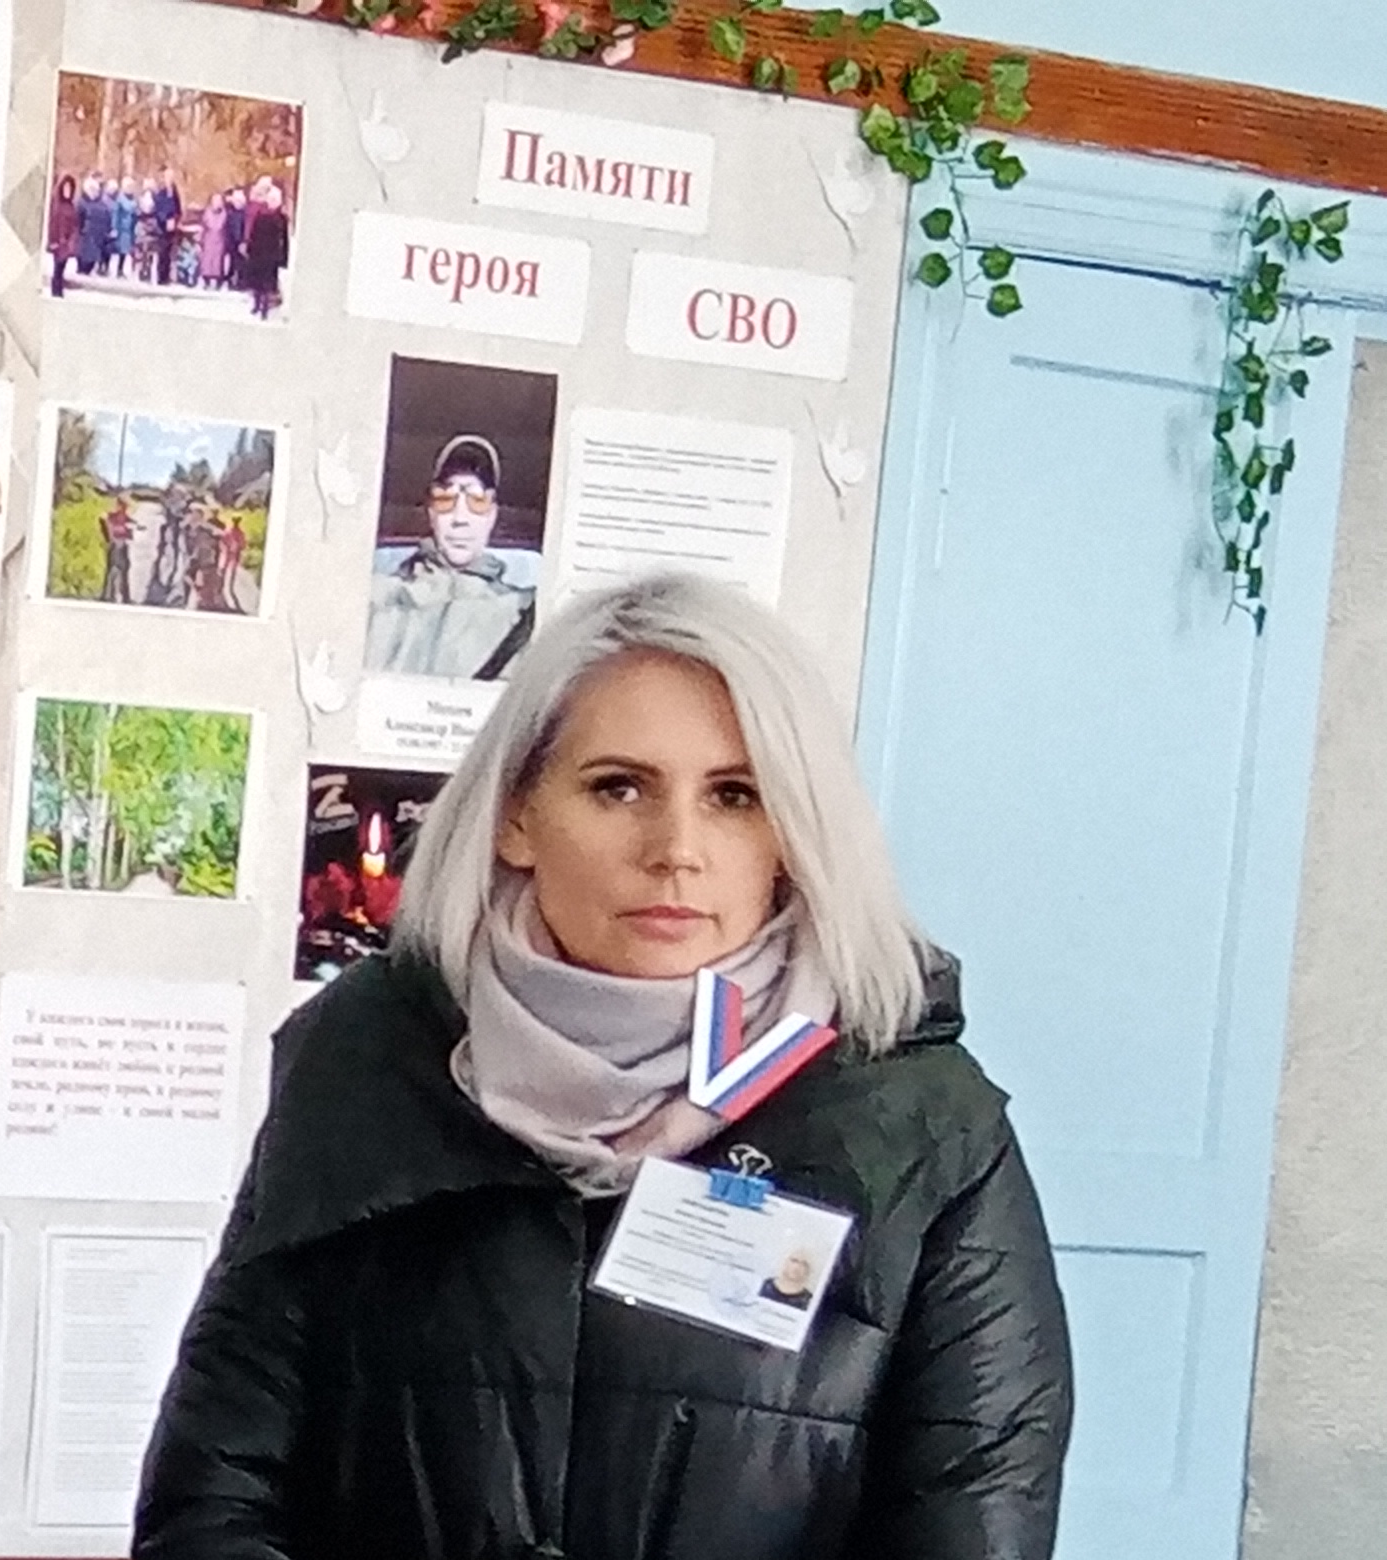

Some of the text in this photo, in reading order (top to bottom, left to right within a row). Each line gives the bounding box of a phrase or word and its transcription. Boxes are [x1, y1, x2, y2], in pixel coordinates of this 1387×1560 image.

[499, 127, 693, 207] Памяти
[400, 242, 541, 303] героя
[687, 287, 798, 349] СВО
